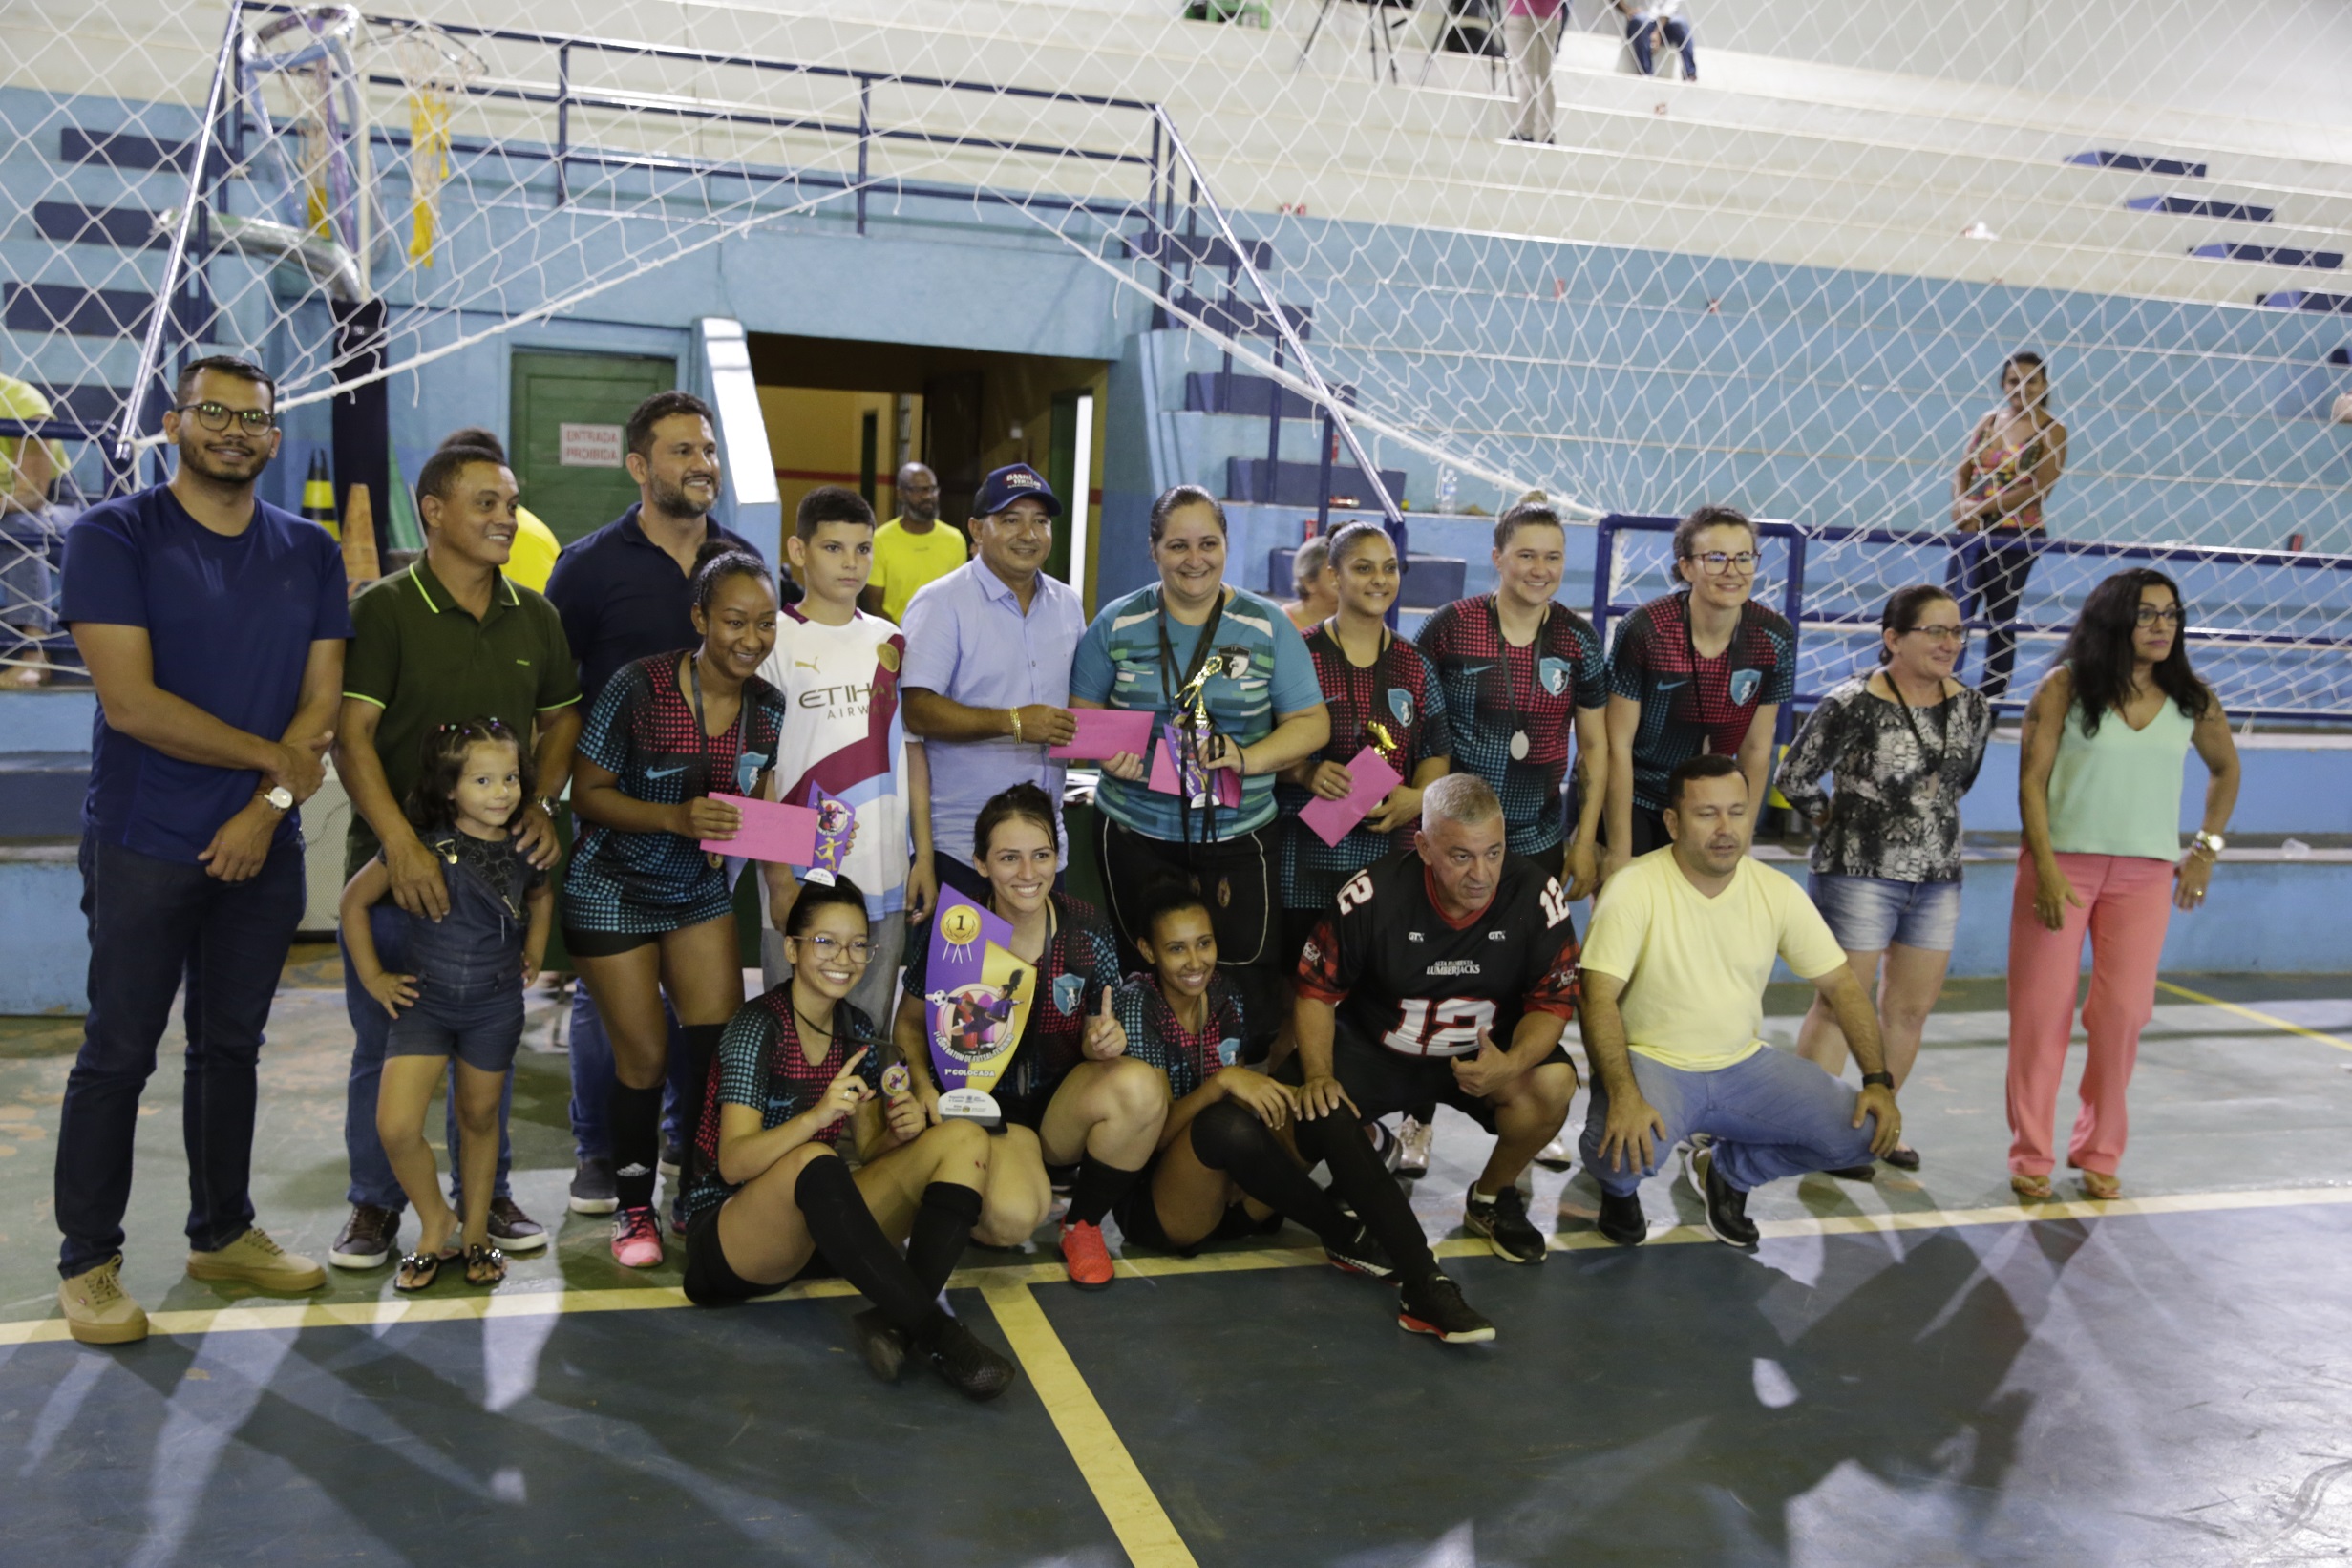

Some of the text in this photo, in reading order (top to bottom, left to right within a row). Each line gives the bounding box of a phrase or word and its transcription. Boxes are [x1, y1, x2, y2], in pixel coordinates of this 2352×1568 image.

[566, 430, 618, 444] ENTRADA
[566, 447, 618, 461] PROIBIDA
[1538, 875, 1571, 930] 12
[956, 915, 965, 931] 1
[1426, 964, 1481, 976] LUMBERJACKS
[1380, 996, 1498, 1057] 12
[945, 1048, 964, 1062] BATOM
[964, 1054, 972, 1063] DE
[952, 1069, 996, 1077] COLOCADA
